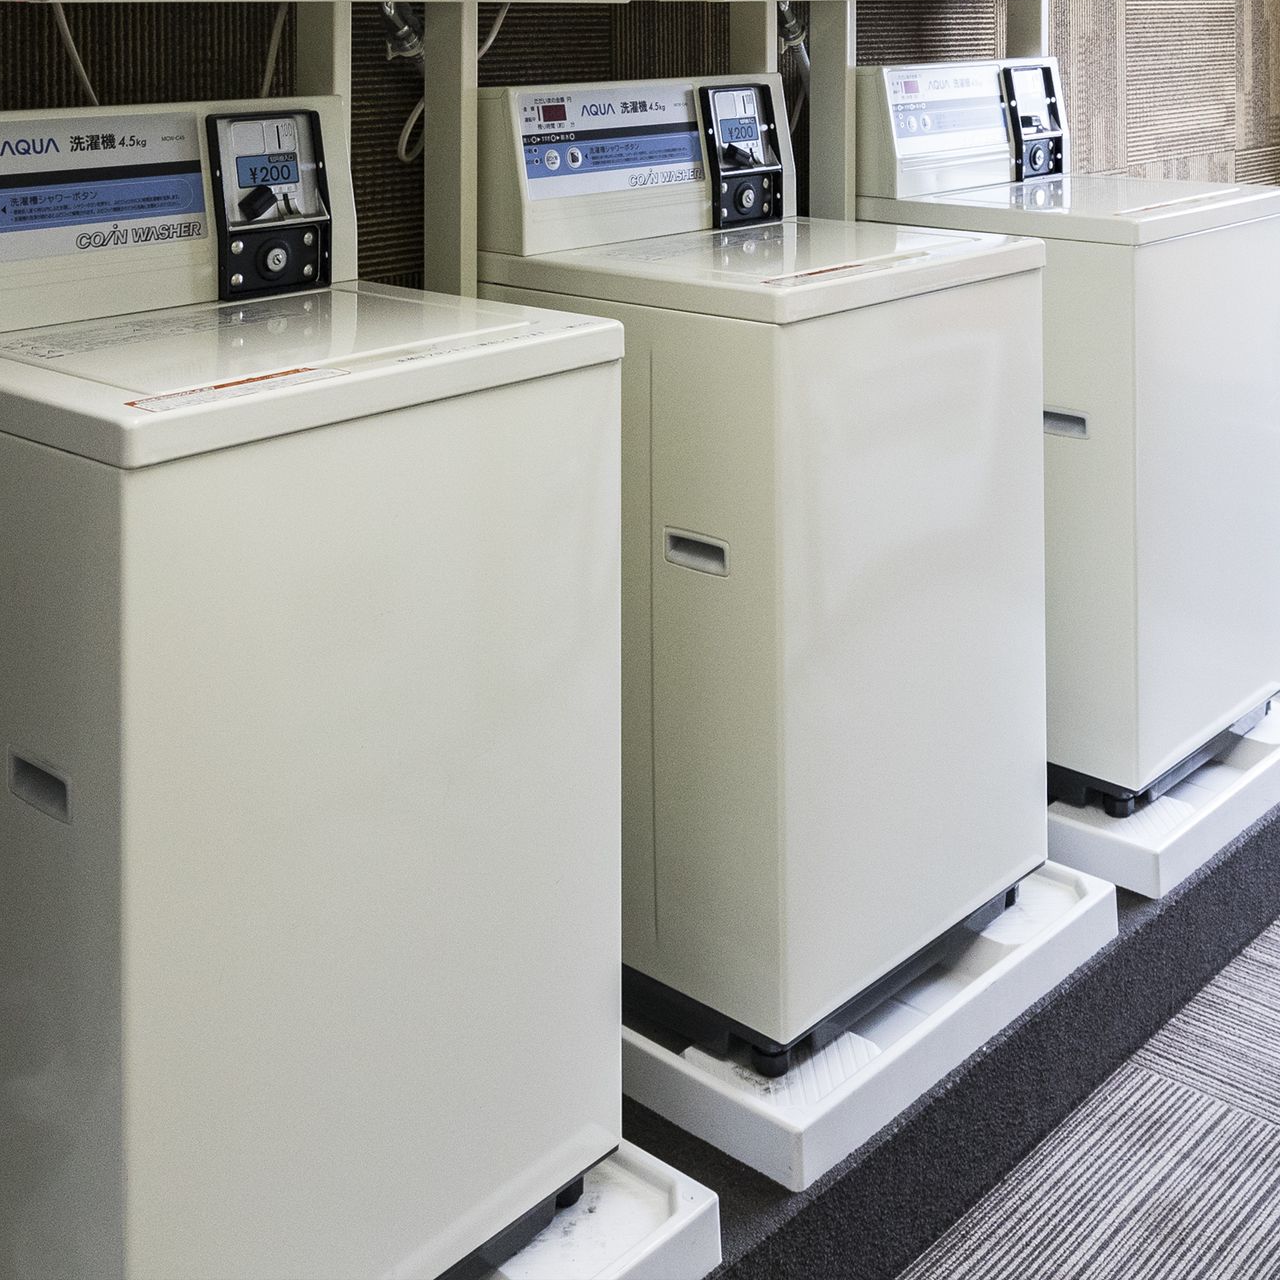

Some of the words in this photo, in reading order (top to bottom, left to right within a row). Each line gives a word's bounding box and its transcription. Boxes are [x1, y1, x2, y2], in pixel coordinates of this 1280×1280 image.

[581, 103, 616, 118] AQUA
[620, 100, 648, 114] 洗濯機
[649, 100, 666, 112] 4.5kg
[728, 125, 754, 140] ¥200
[0, 137, 60, 157] AQUA
[69, 133, 117, 153] 洗濯機
[118, 135, 147, 149] 4.5kg
[249, 164, 291, 184] ¥200
[660, 168, 704, 184] WASHER
[10, 191, 98, 207] 洗濯槽シャワーボタン
[131, 221, 202, 242] WASHER
